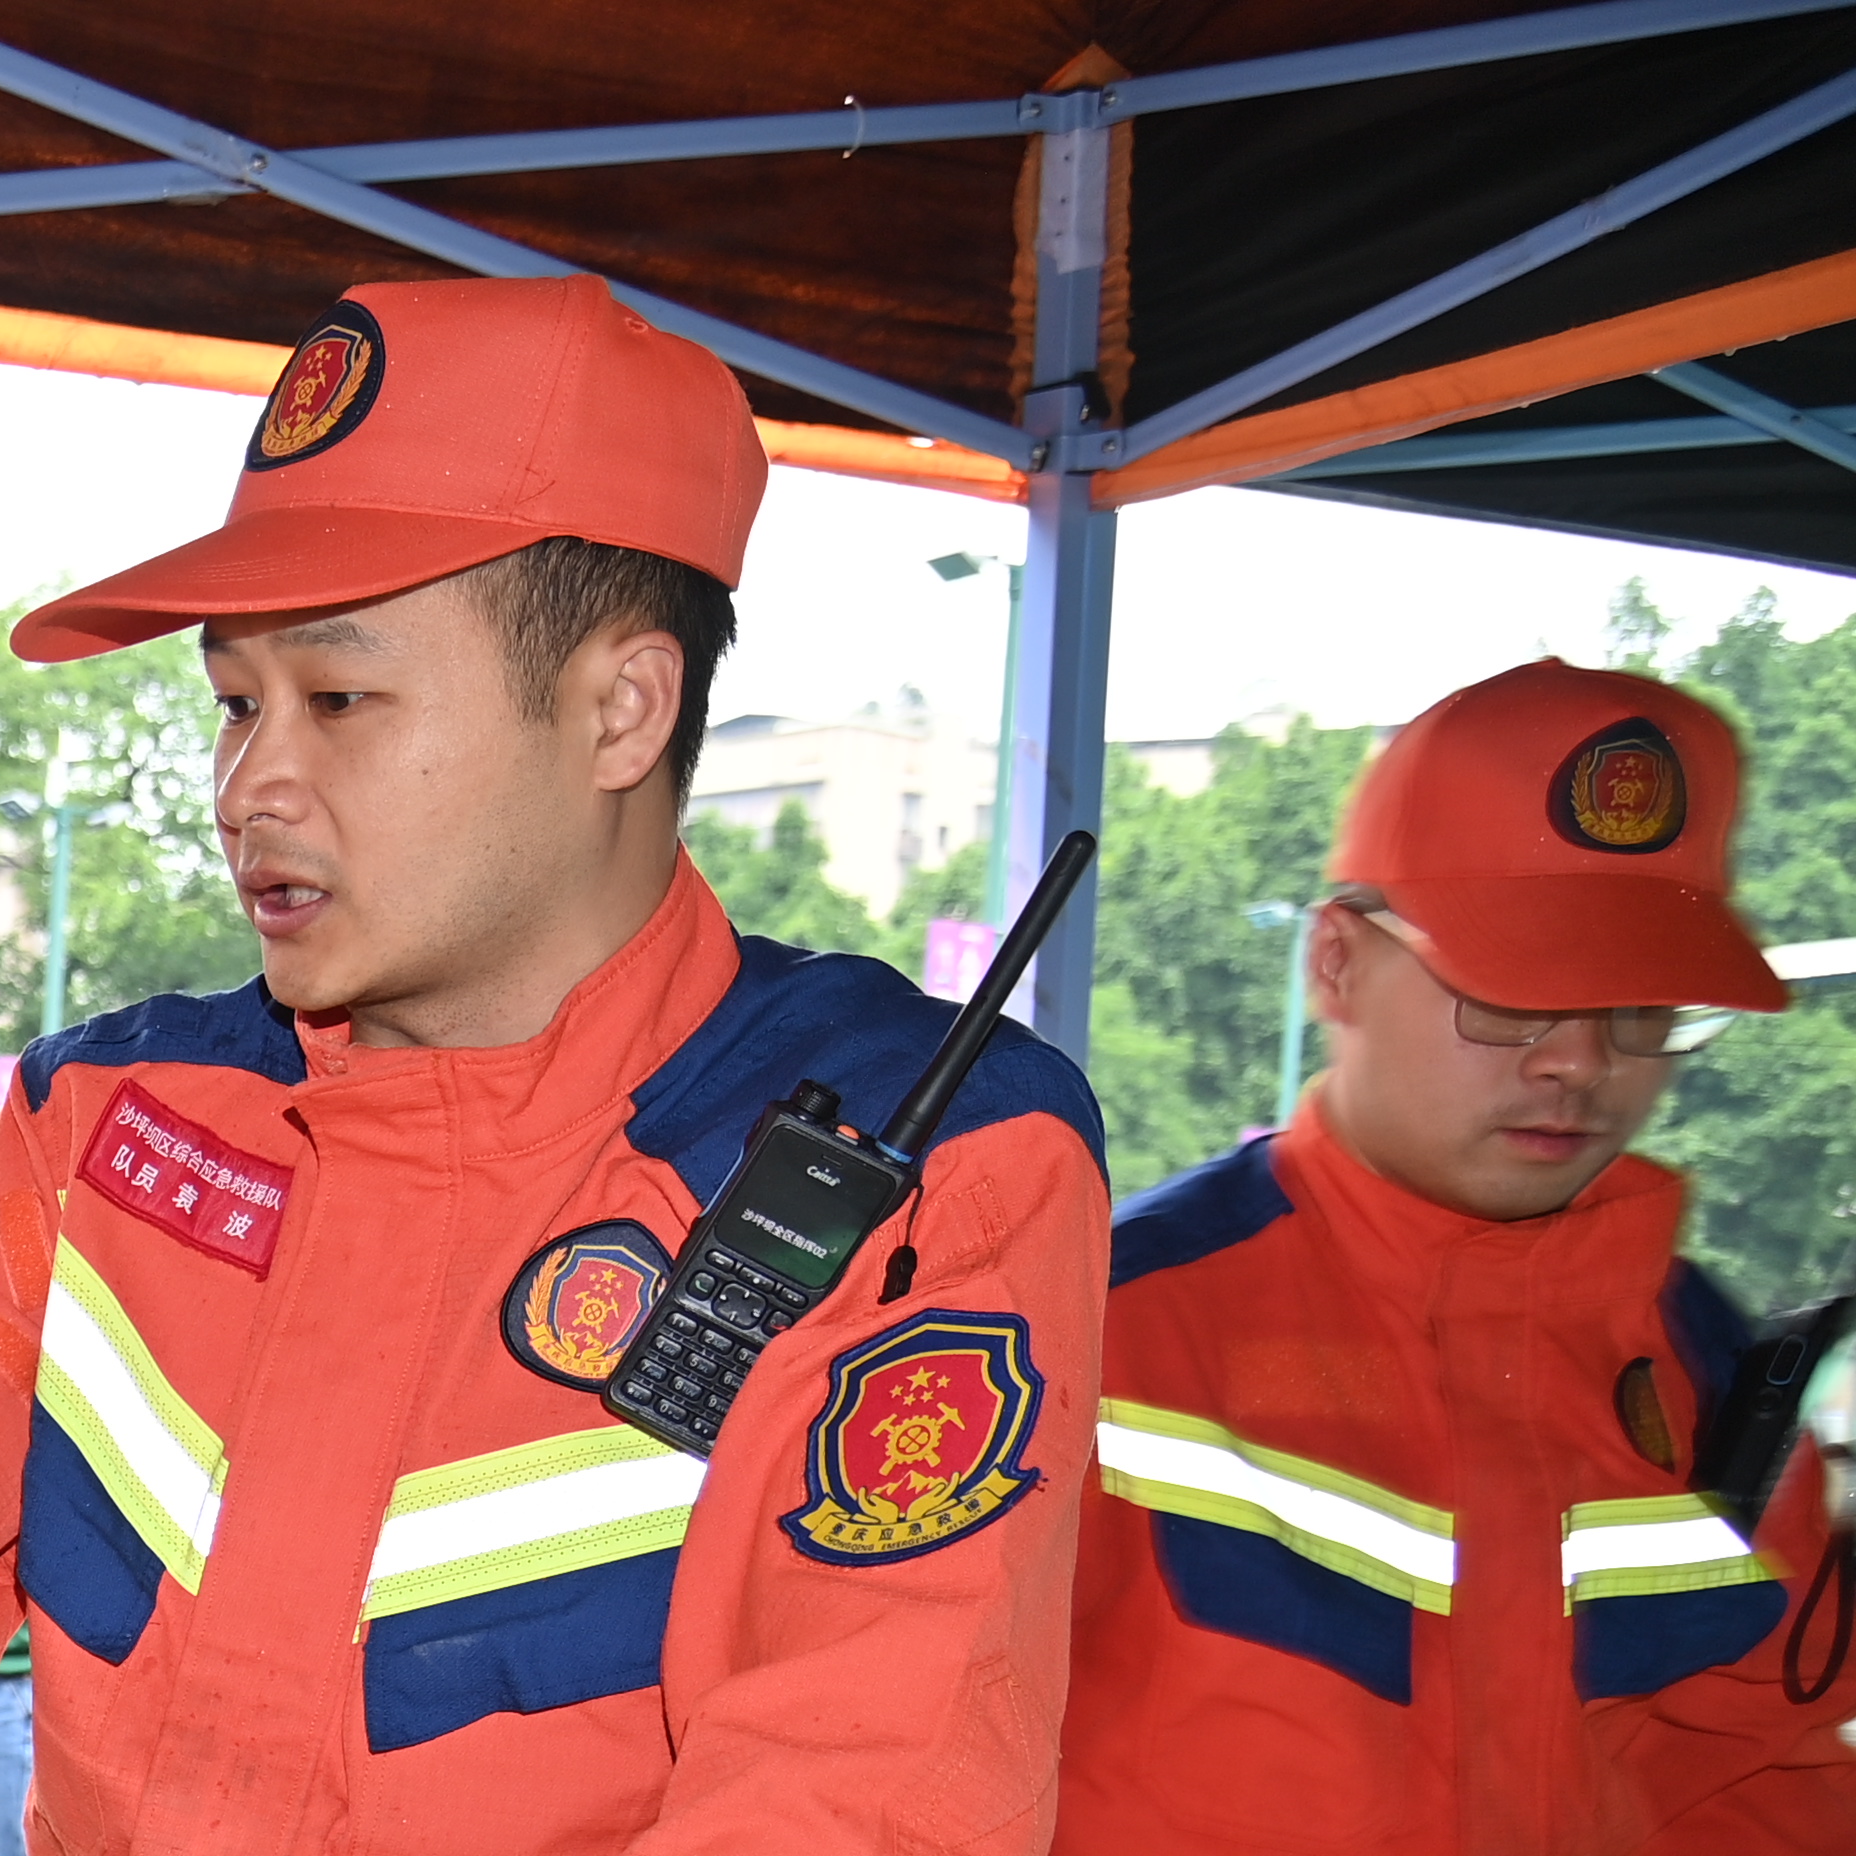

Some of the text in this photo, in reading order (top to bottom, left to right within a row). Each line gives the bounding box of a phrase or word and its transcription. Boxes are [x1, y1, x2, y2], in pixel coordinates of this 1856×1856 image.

[115, 1102, 283, 1211] 沙坪坝区综合应急救援队
[111, 1144, 254, 1240] 队员 袁 波
[740, 1207, 828, 1260] 沙坪坝全区指挥02
[828, 1497, 983, 1542] 重庆应急救援
[881, 1530, 943, 1551] EMERGENCY
